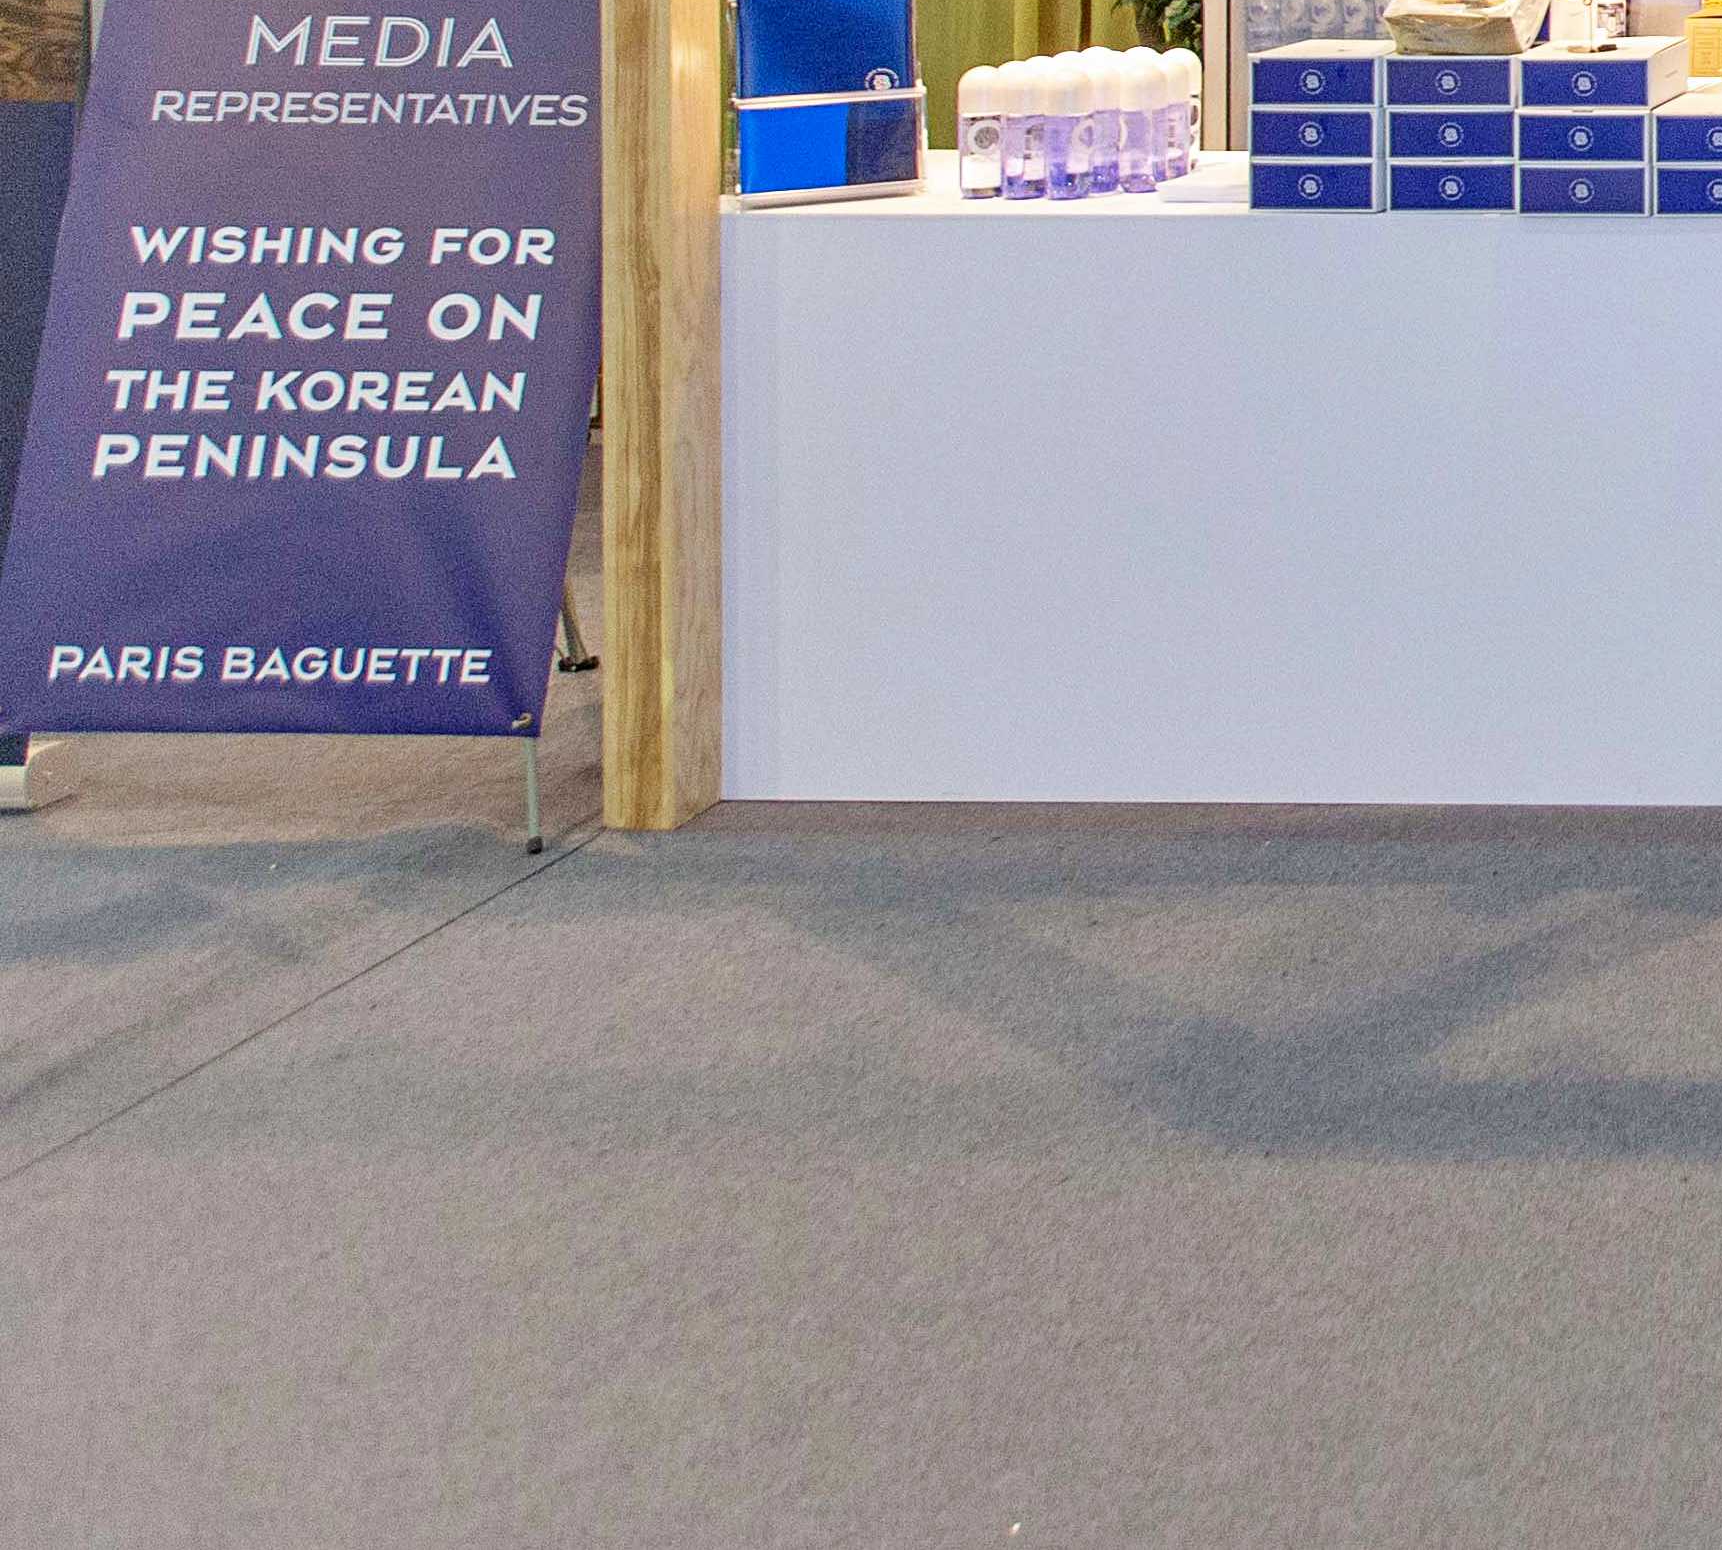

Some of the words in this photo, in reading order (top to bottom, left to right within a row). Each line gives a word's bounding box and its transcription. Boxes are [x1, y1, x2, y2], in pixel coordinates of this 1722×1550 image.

[246, 15, 512, 67] MEDIA
[152, 91, 587, 126] REPRESENTATIVES
[131, 227, 403, 264] WISHING
[431, 229, 553, 265] FOR
[119, 292, 392, 340] PEACE
[428, 294, 541, 340] ON
[107, 371, 233, 410] THE
[256, 371, 525, 411] KOREAN
[93, 434, 515, 479] PENINSULA
[49, 646, 203, 682] PARIS
[222, 647, 491, 683] BAGUETTE
